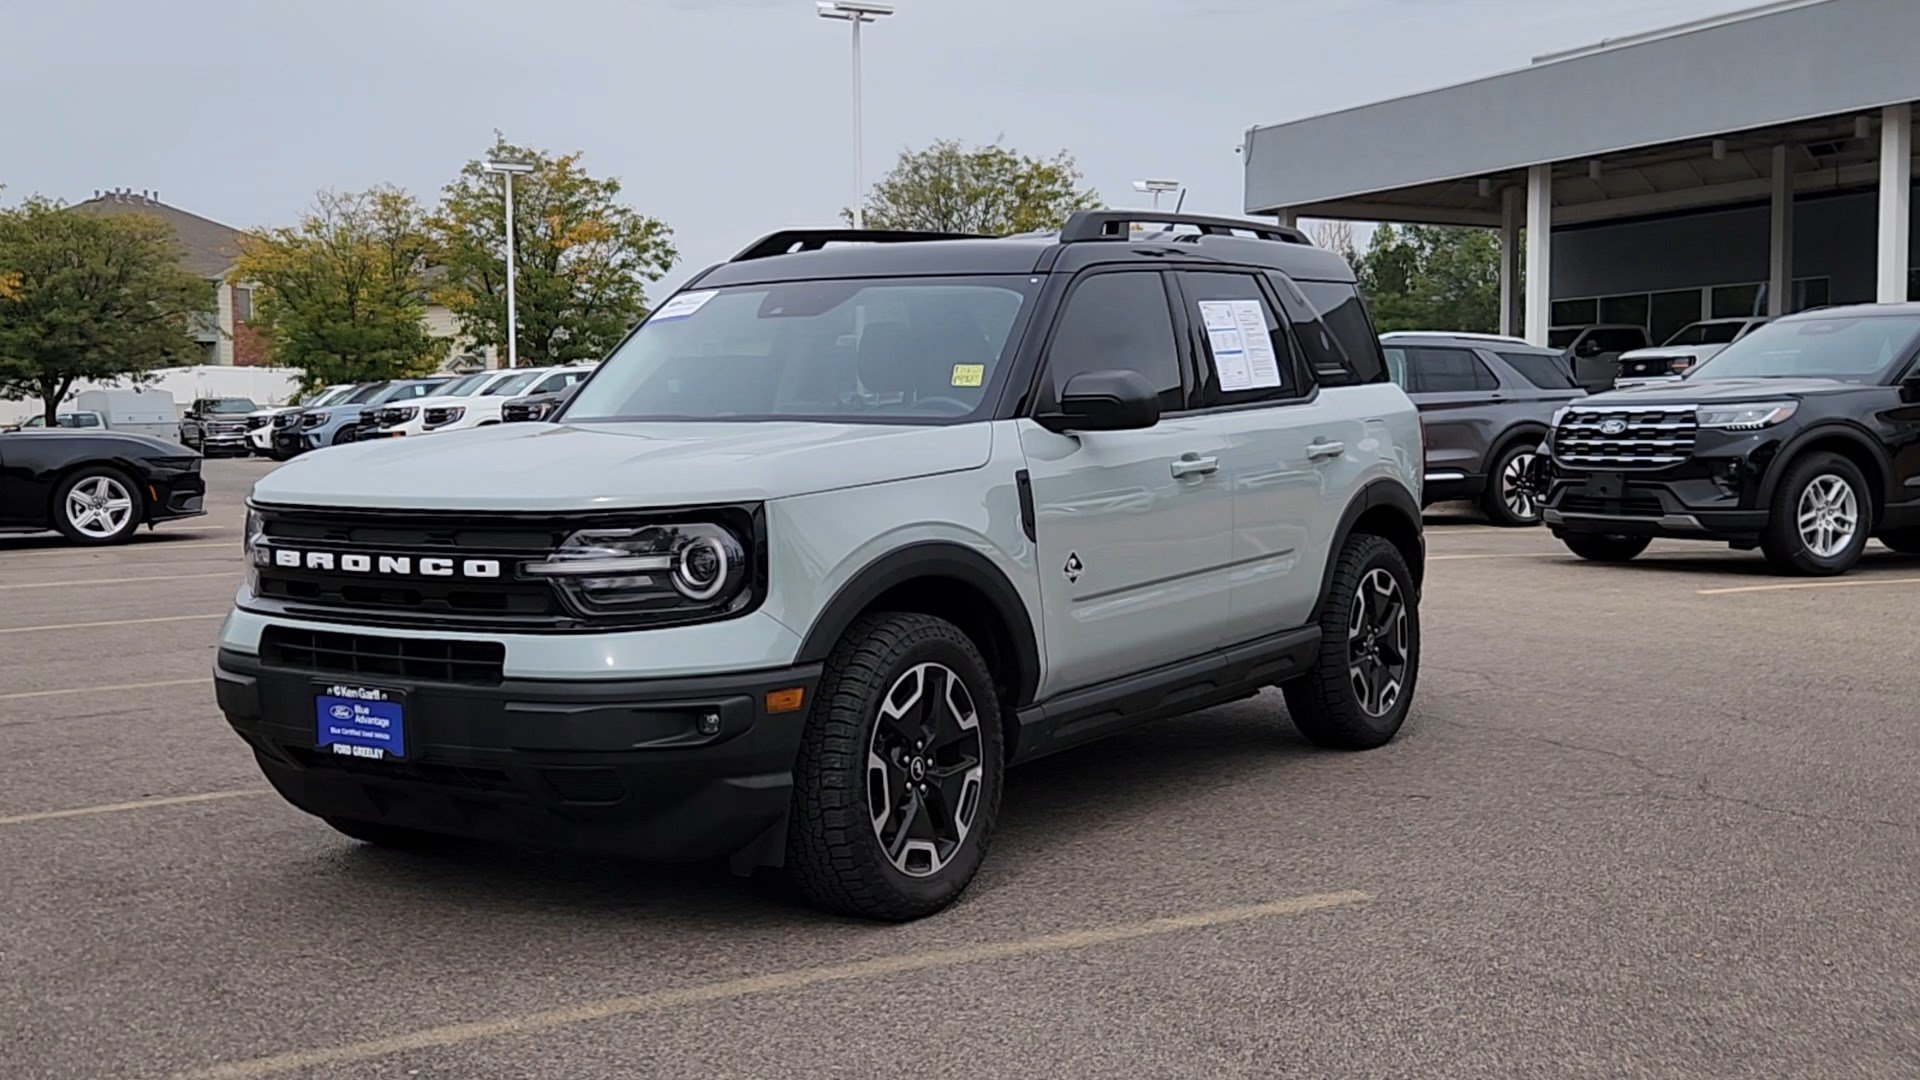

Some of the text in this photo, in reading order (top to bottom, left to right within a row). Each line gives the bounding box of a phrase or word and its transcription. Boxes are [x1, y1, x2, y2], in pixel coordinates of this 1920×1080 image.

[276, 549, 500, 578] BRONCO
[354, 704, 369, 715] Blue
[355, 715, 389, 728] Advantage
[333, 743, 384, 760] FORD GREELEY
